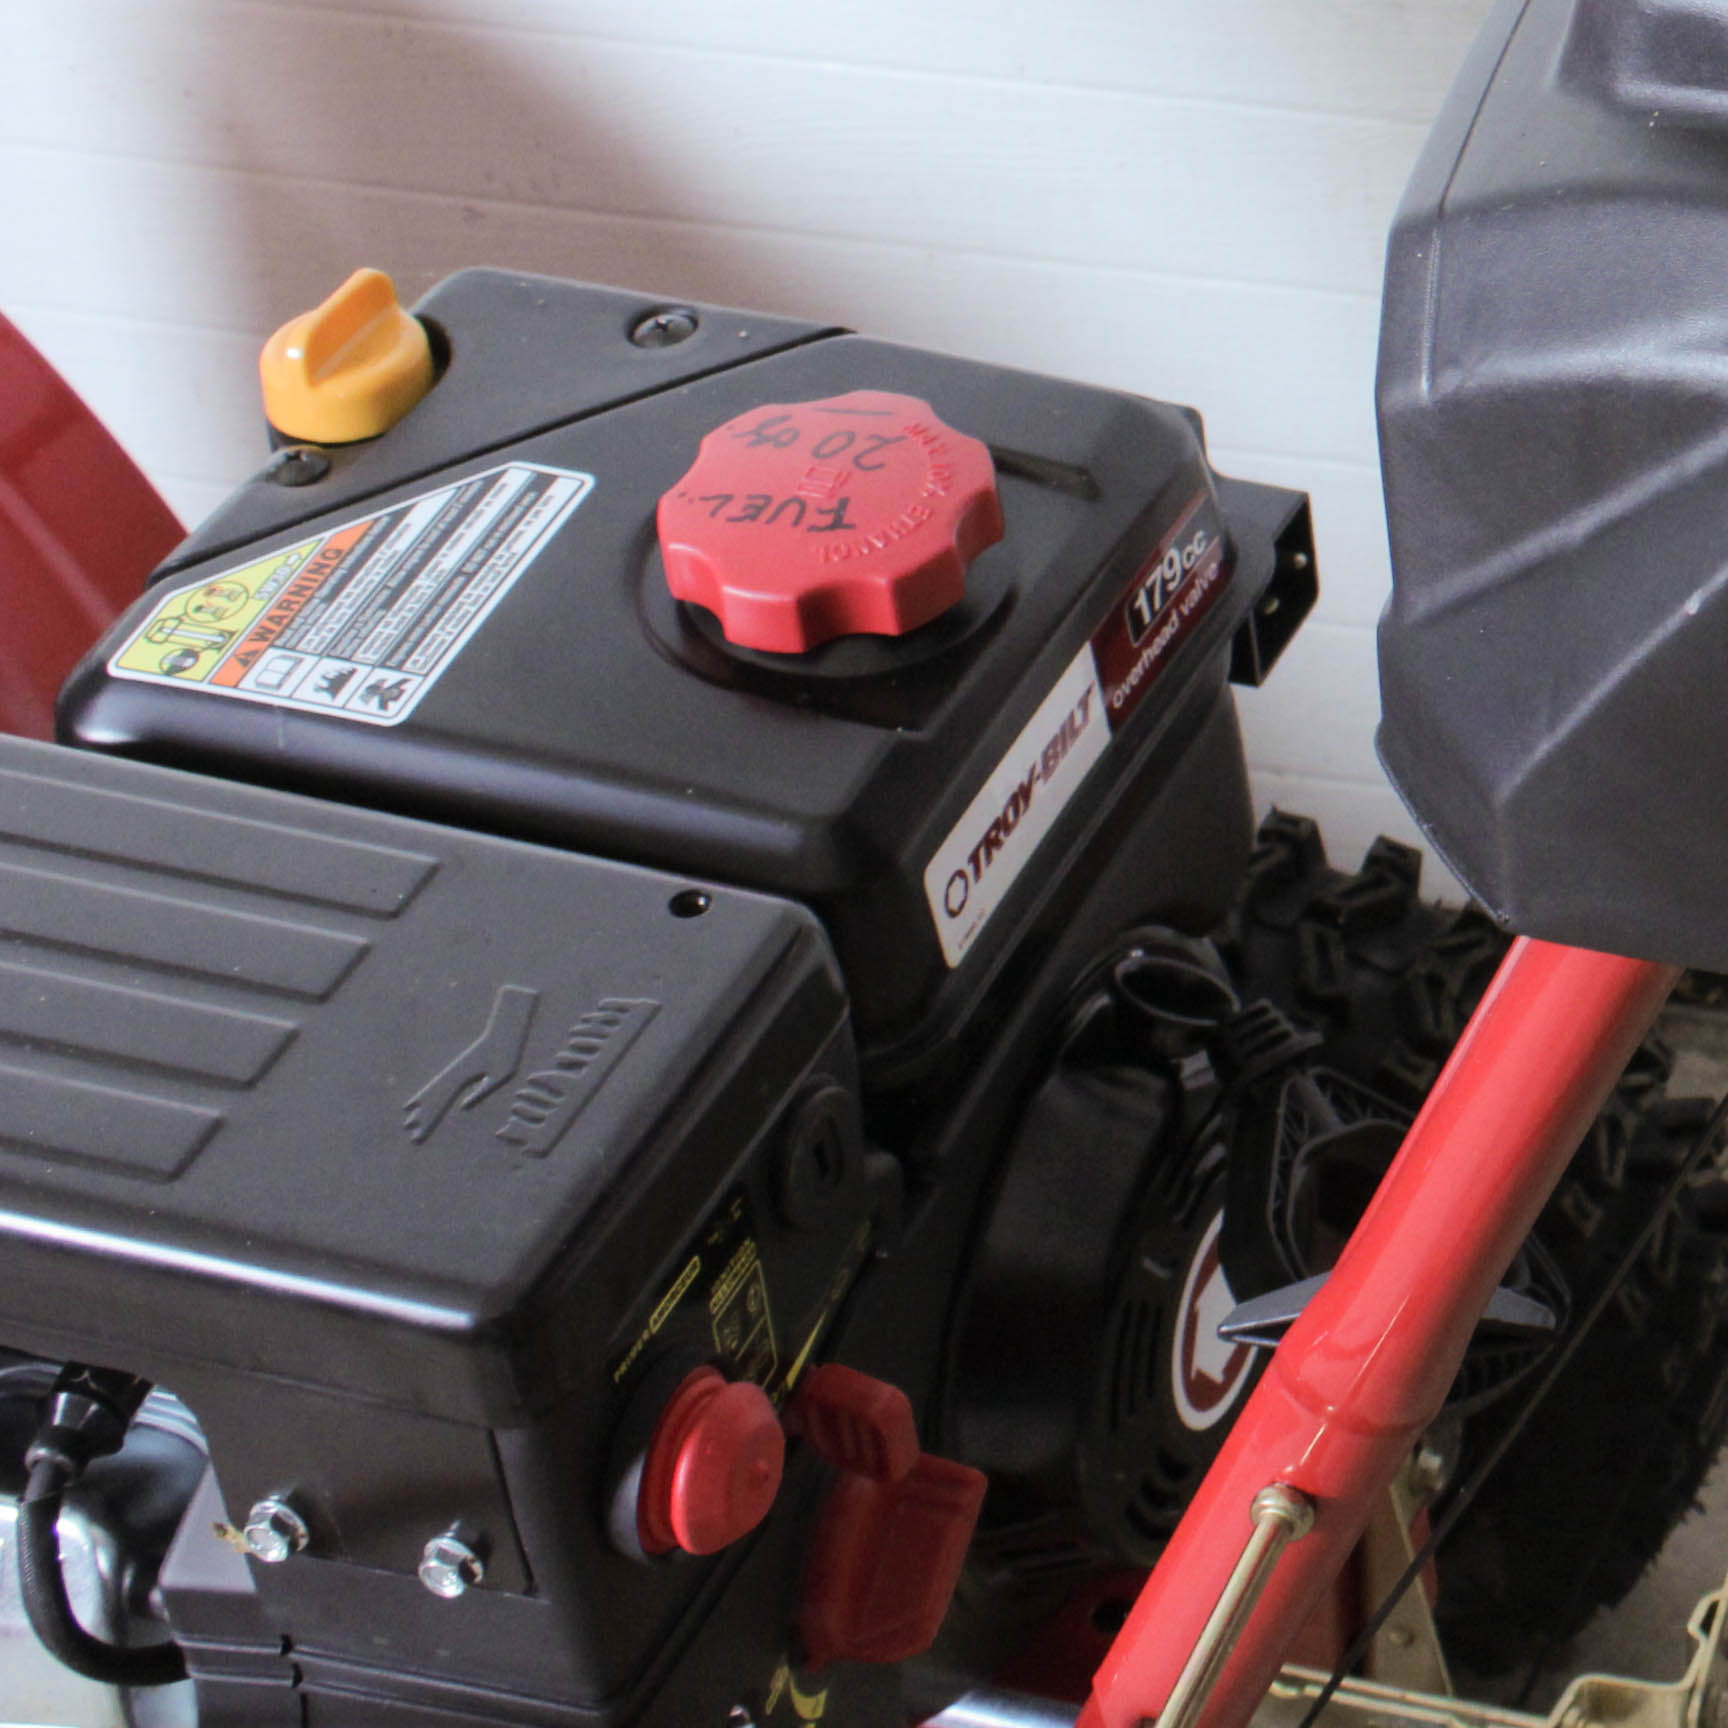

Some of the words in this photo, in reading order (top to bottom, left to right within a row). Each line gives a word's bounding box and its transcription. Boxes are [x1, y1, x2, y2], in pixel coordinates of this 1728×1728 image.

[812, 431, 909, 471] 20
[248, 548, 344, 643] WARNING
[1112, 610, 1180, 708] overhead
[1179, 561, 1220, 614] valve
[966, 679, 1097, 884] TROY-BILT
